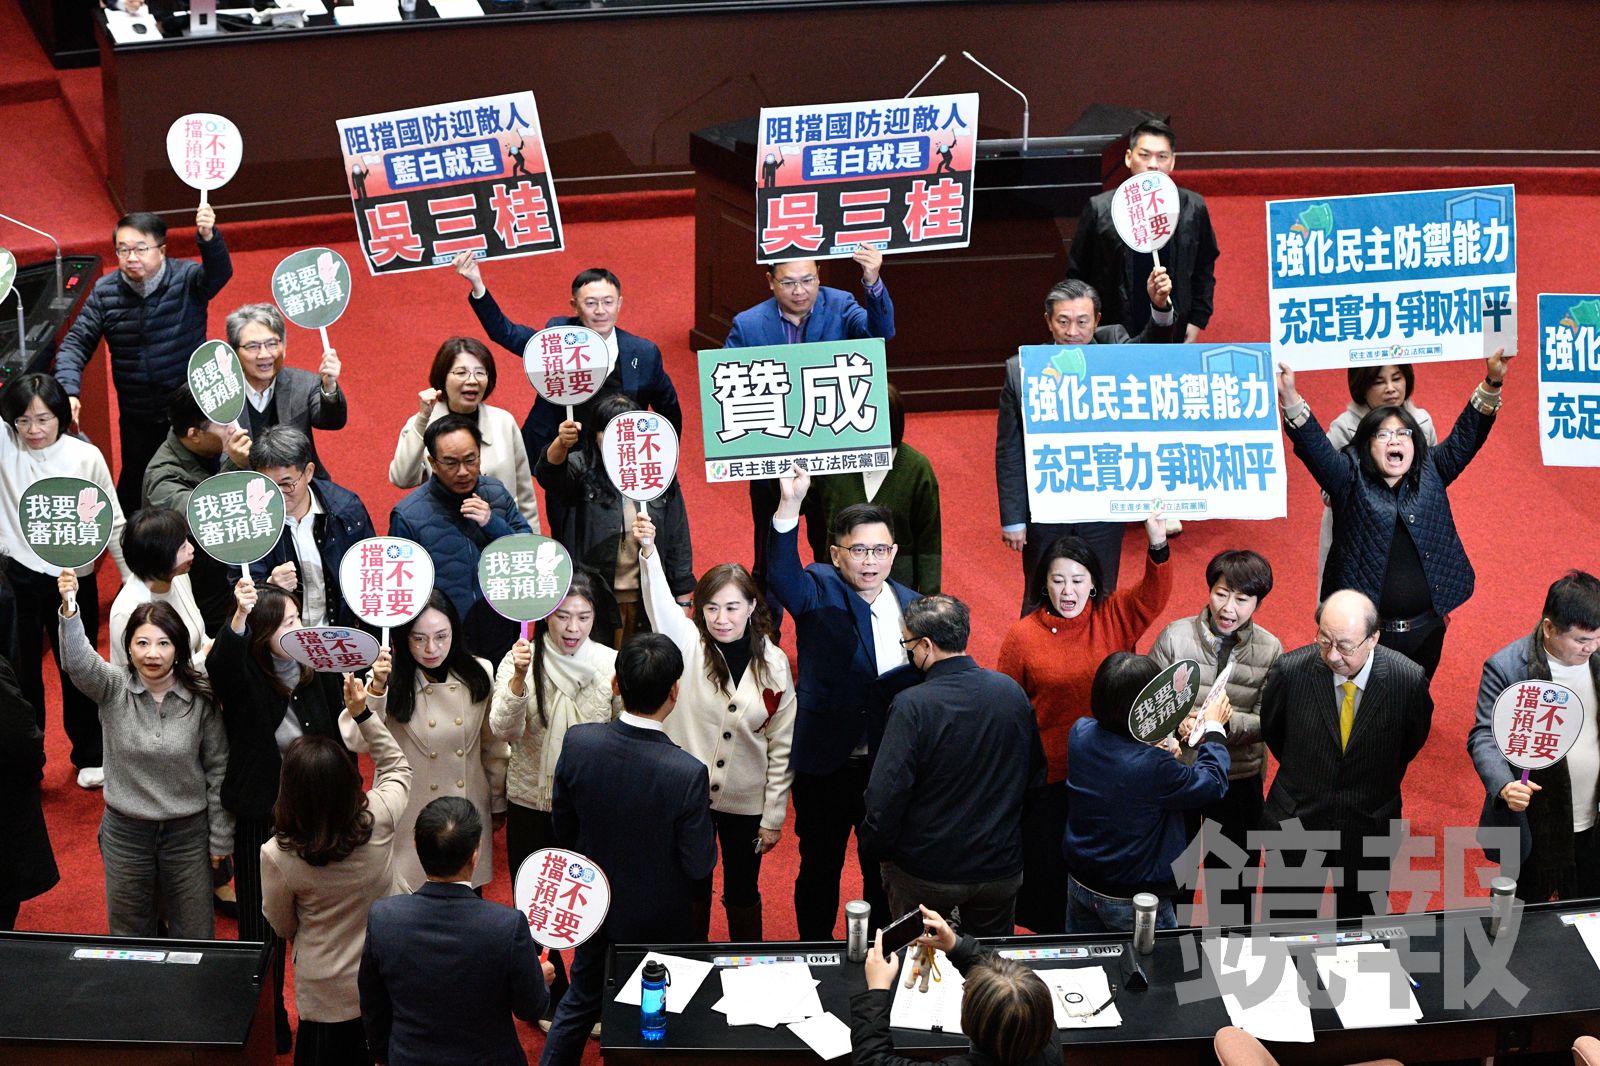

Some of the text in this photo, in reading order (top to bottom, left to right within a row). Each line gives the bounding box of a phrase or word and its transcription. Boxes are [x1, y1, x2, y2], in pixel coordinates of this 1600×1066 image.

[343, 101, 530, 155] 阻擋國防迎敵人
[765, 102, 967, 146] 阻擋國防迎敵人
[184, 119, 203, 180] 擋預算
[204, 133, 226, 180] 不要
[391, 143, 497, 185] 藍白就是
[809, 141, 922, 177] 藍白就是
[364, 180, 555, 267] 吳三桂
[760, 177, 965, 255] 吳三桂
[1123, 182, 1151, 247] 擋預算
[1143, 188, 1171, 241] 不要
[1275, 217, 1510, 278] 強化民主防禦能力
[277, 264, 320, 297] 我要
[282, 279, 345, 317] 審預算
[1278, 284, 1512, 346] 充足實力 爭取和平
[540, 333, 567, 399] 擋預算
[564, 345, 595, 396] 不要
[1545, 325, 1600, 372] 強化
[191, 357, 222, 394] 我要
[200, 371, 242, 414] 審預算
[711, 352, 878, 444] 贊成
[1027, 373, 1270, 423] 強化民主防禦能力
[1547, 392, 1600, 440] 充足
[616, 418, 640, 492] 擋預算
[636, 433, 664, 490] 不要
[1032, 441, 1277, 494] 充足實力 爭取和平
[26, 494, 77, 520] 我要
[194, 489, 247, 522] 我要
[199, 512, 276, 547] 審預算
[27, 520, 102, 546] 審預算
[360, 543, 384, 617] 擋預算
[385, 560, 414, 617] 不要
[485, 551, 535, 577] 我要
[486, 574, 560, 601] 審預算
[295, 631, 336, 669] 擋預算
[324, 637, 367, 667] 不要
[1134, 680, 1175, 723] 我要
[1138, 683, 1194, 739] 審預算
[1505, 685, 1541, 757] 擋預算
[1529, 703, 1567, 761] 不要
[528, 852, 568, 932] 擋預算
[548, 877, 592, 944] 不要
[810, 955, 836, 963] 004
[1094, 946, 1121, 954] 005
